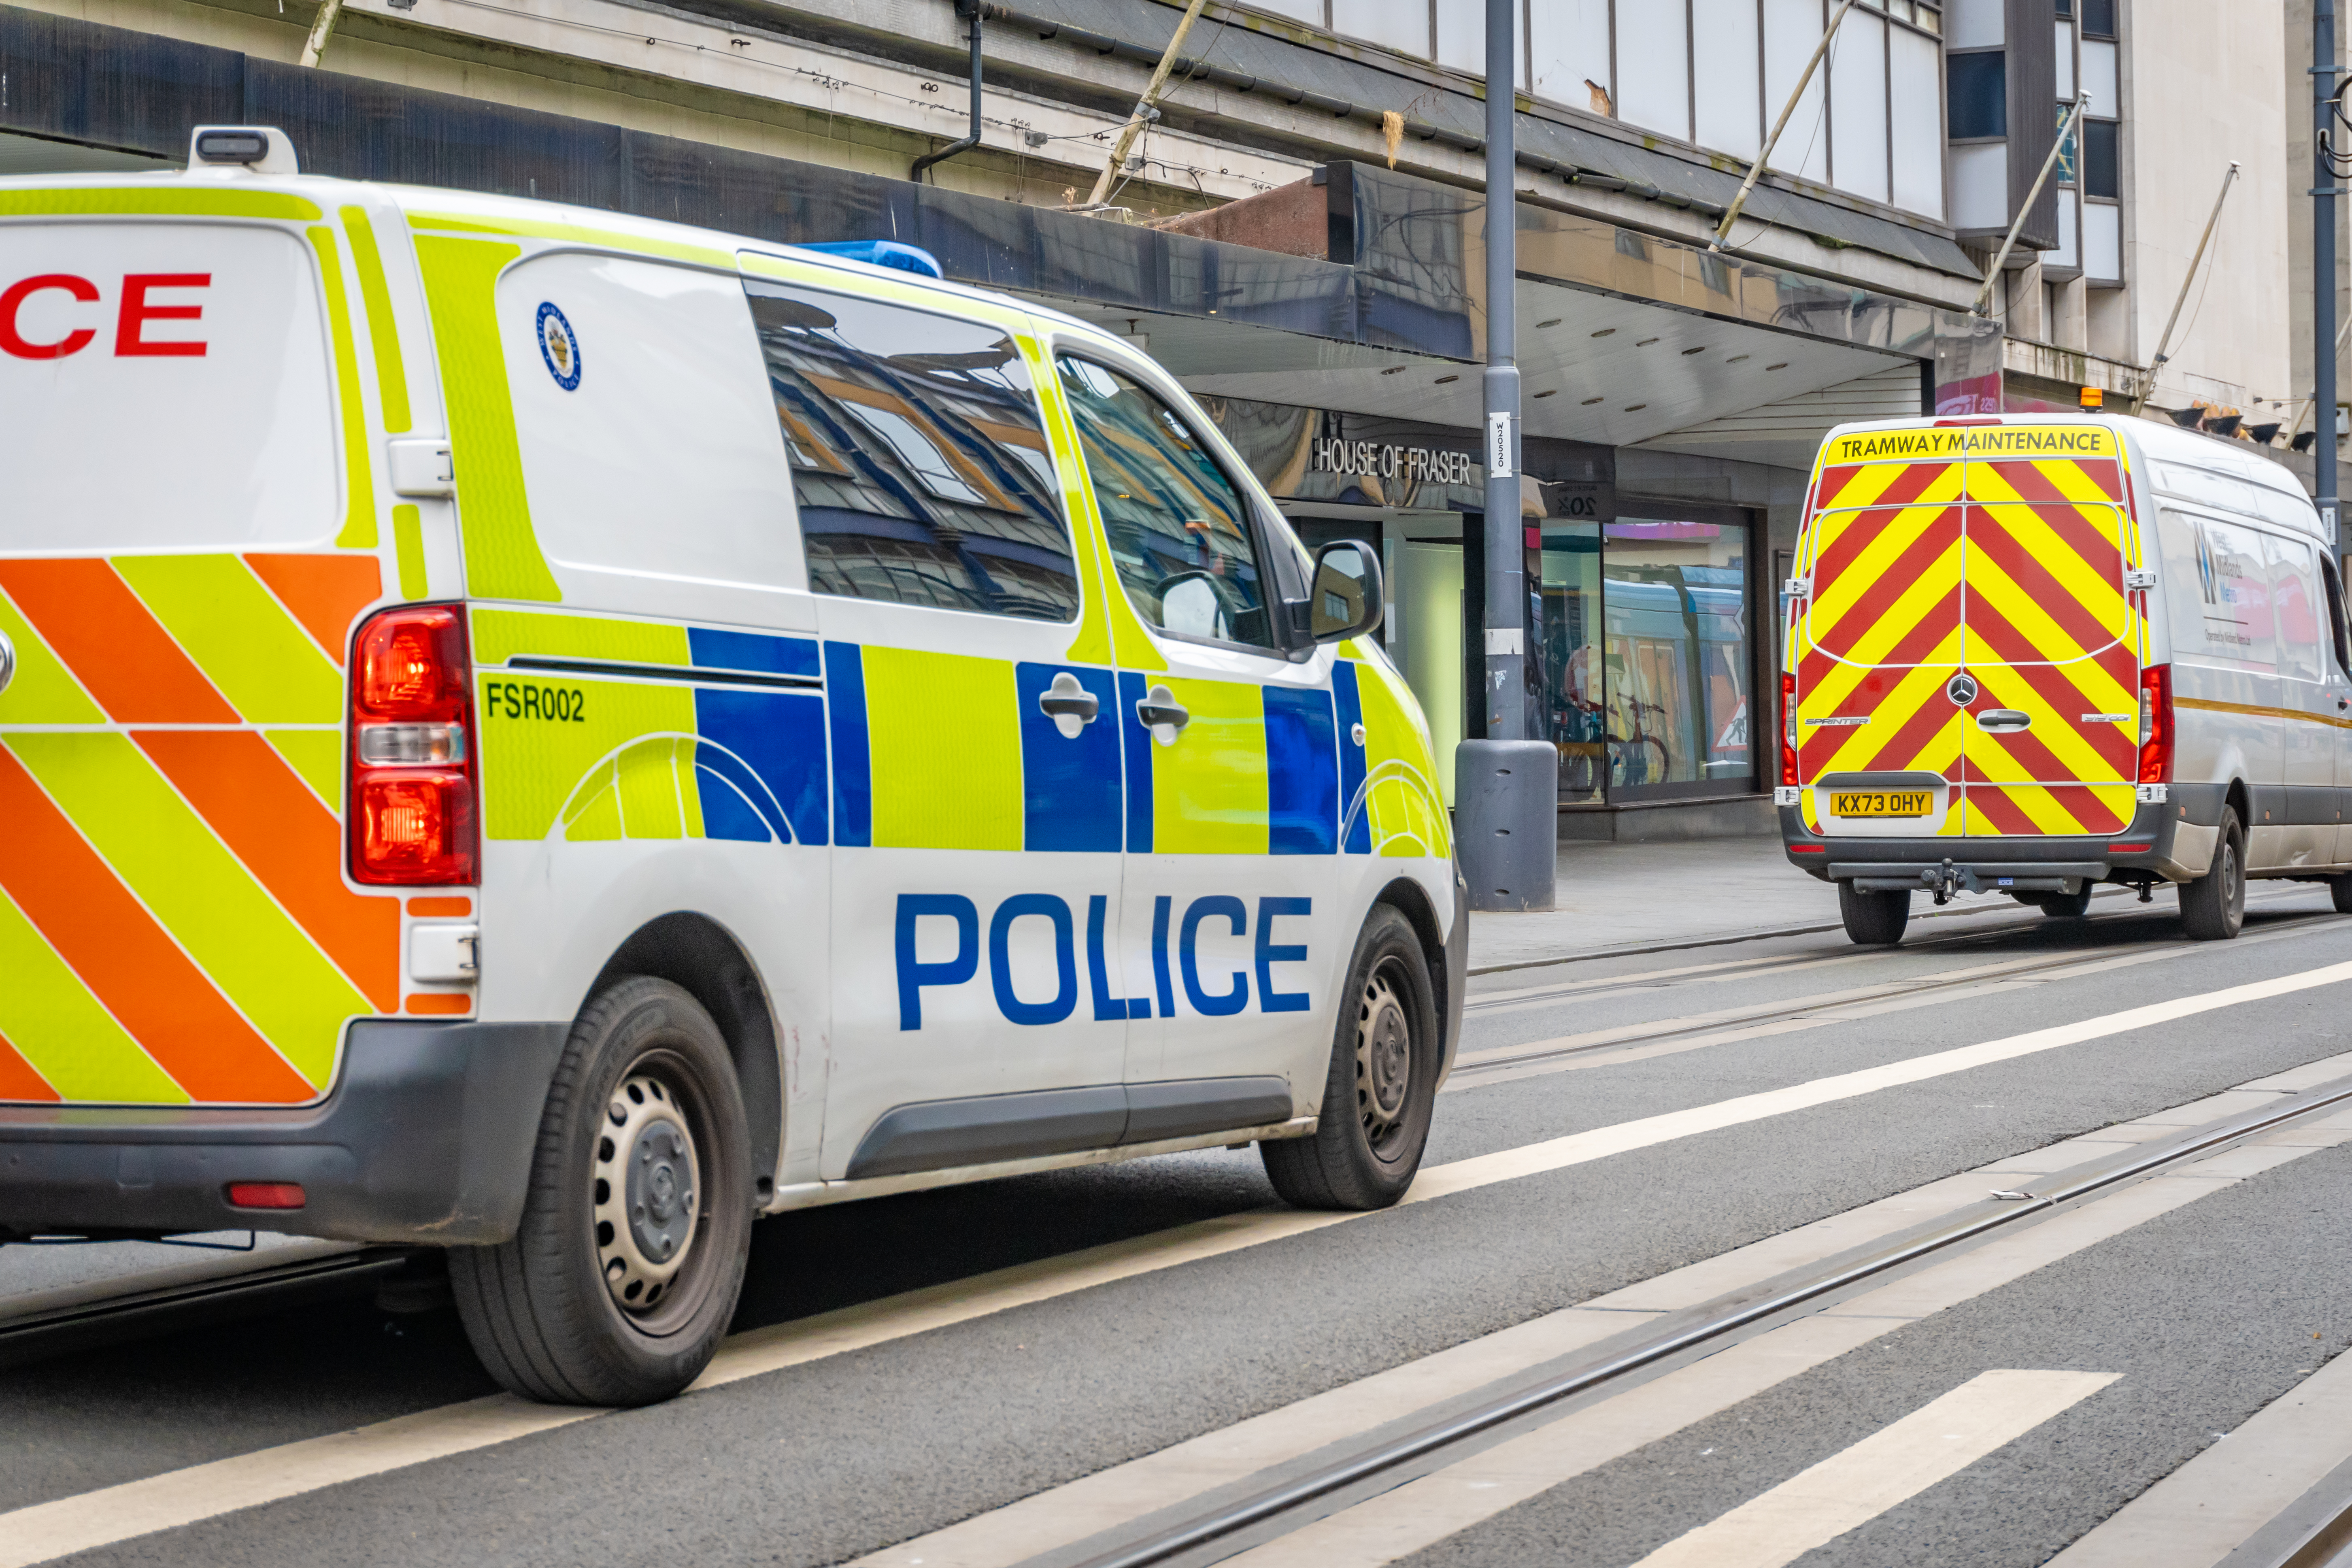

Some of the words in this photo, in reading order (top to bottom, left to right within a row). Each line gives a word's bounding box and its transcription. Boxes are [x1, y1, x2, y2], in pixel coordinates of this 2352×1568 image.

[1842, 434, 1944, 457] TRAMWAY
[1948, 432, 2100, 451] MAINTENANCE
[1319, 437, 1377, 476] HOUSE
[1382, 445, 1404, 478] OF
[1408, 447, 1470, 485] FRASER
[2210, 528, 2227, 550] West
[2216, 554, 2243, 579] Midlands
[2220, 581, 2237, 603] Metro
[2205, 628, 2221, 644] Operated
[2224, 631, 2237, 644] Midland
[487, 682, 585, 722] FSR002
[1838, 795, 1884, 812] KX73
[1890, 794, 1925, 811] OHY
[895, 893, 1312, 1031] POLICE
